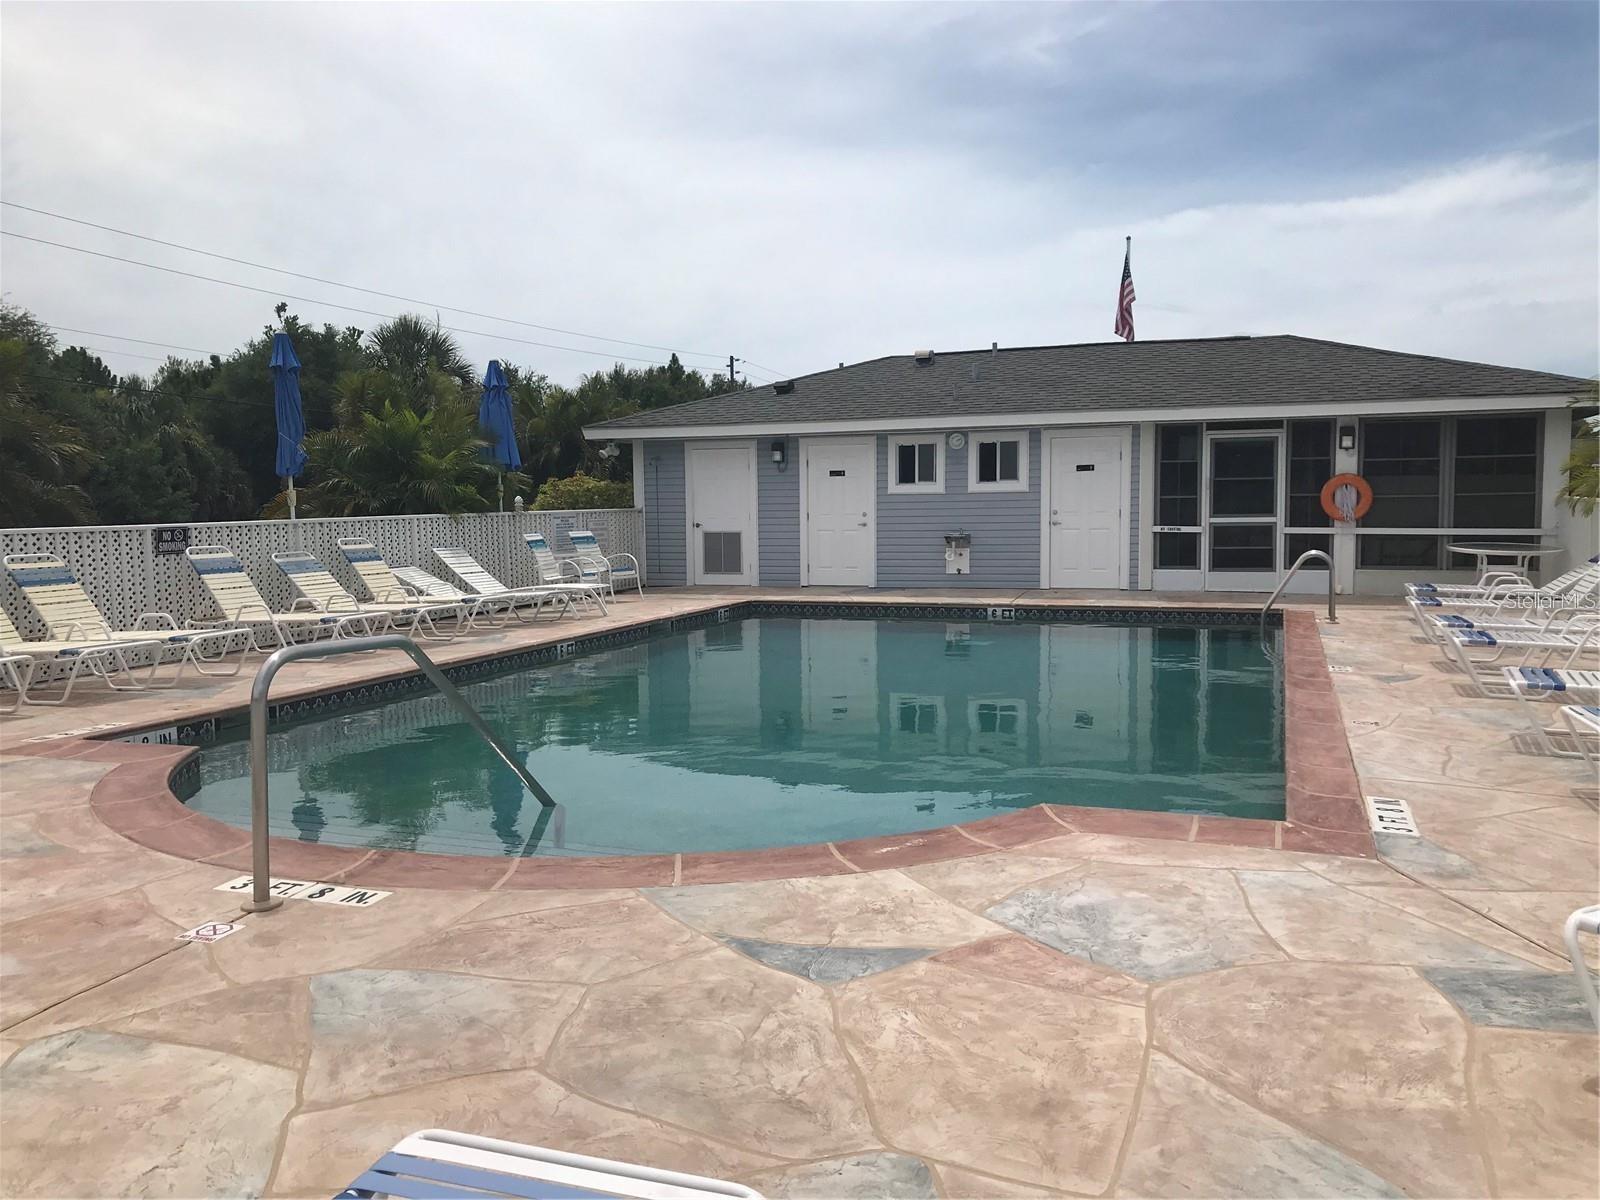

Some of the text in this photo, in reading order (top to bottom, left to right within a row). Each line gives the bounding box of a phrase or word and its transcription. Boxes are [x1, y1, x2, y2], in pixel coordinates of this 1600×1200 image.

[162, 531, 171, 541] NO
[159, 541, 186, 552] SMOKING
[269, 881, 304, 895] FT.
[307, 887, 335, 899] 8
[339, 890, 378, 905] IN.
